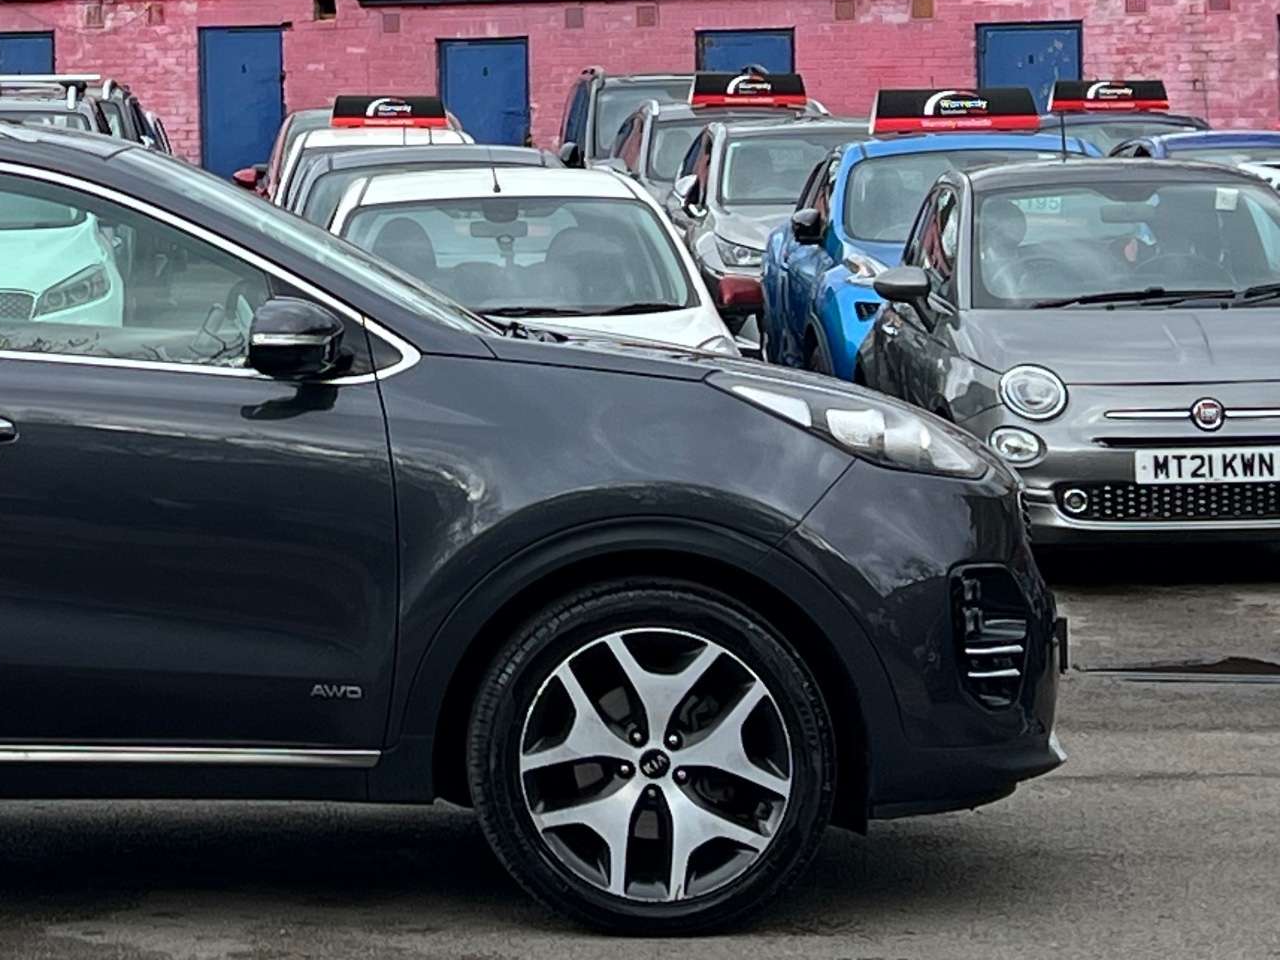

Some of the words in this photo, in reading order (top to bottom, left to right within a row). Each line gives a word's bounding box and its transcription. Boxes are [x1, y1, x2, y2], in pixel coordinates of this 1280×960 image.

[1153, 455, 1214, 479] MT21
[1222, 453, 1274, 478] KWN
[310, 684, 362, 699] AWD
[642, 754, 668, 774] KIA
